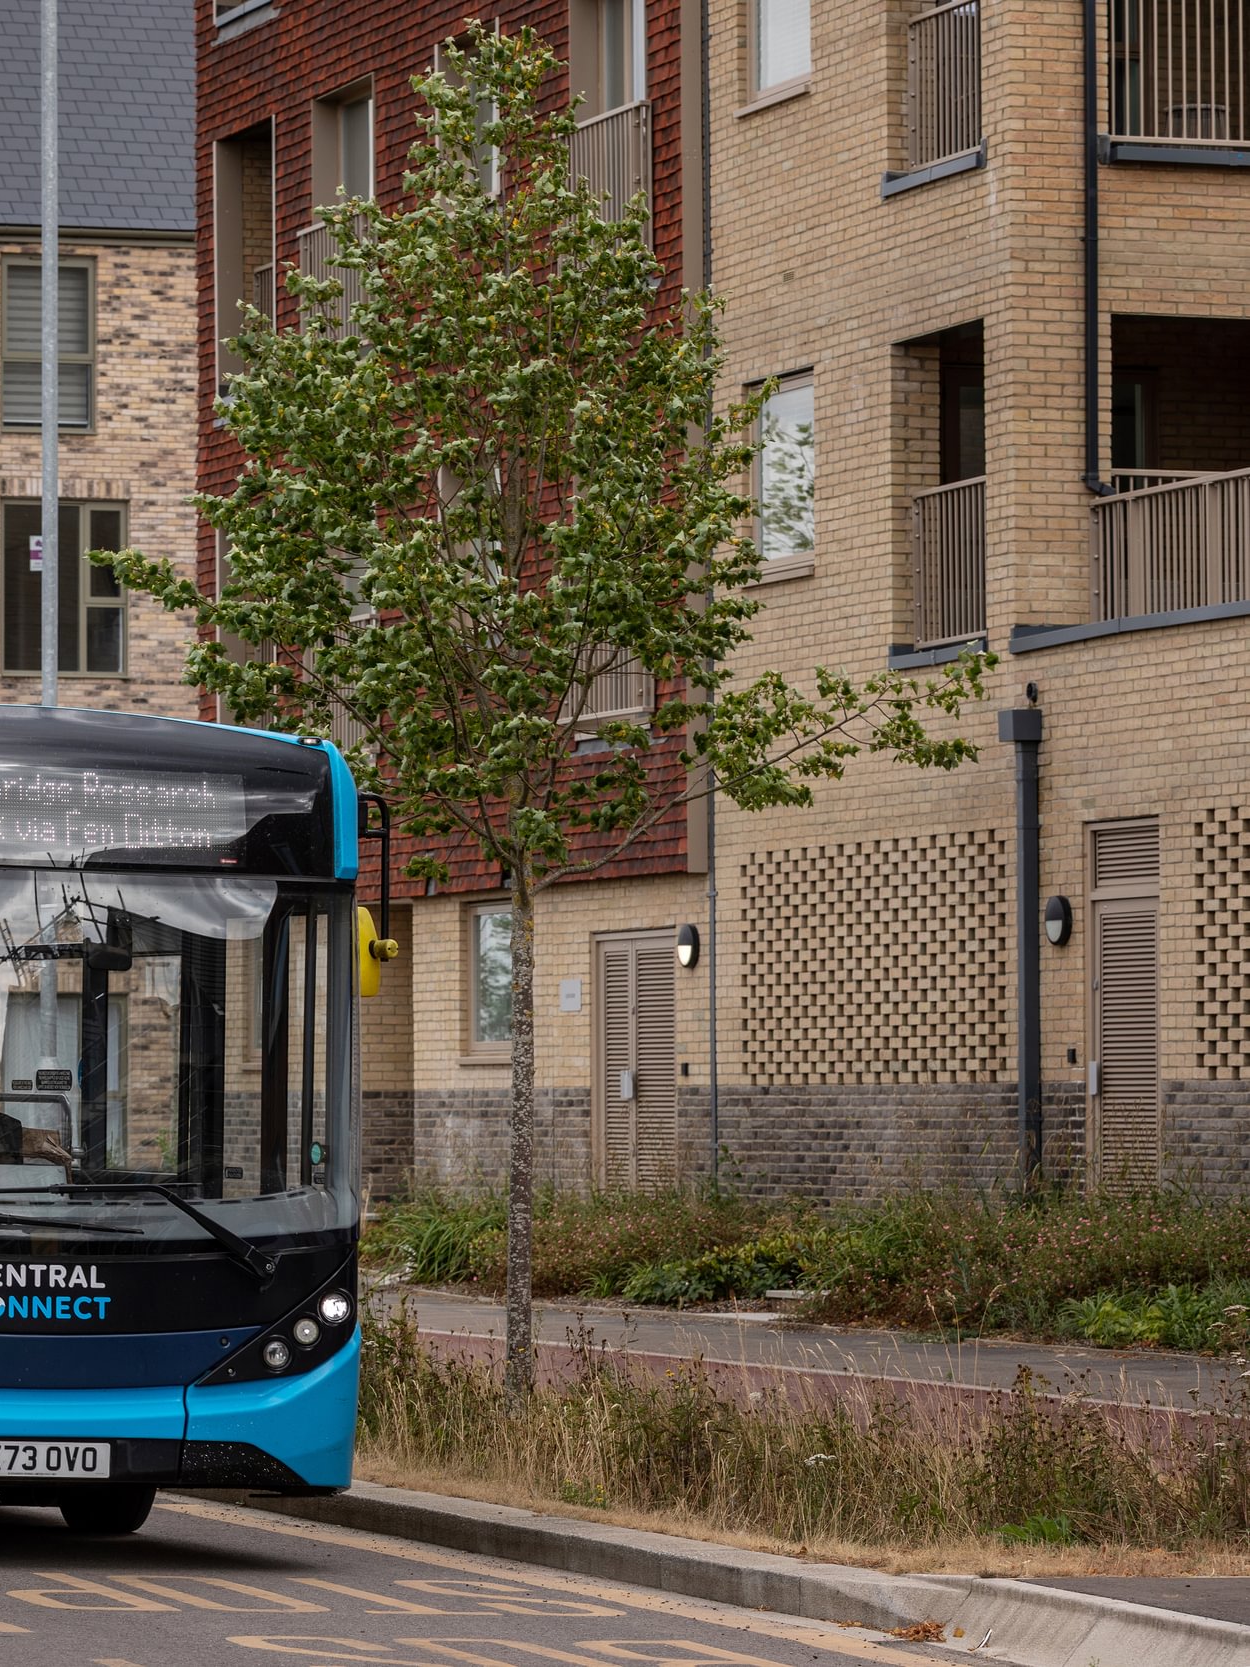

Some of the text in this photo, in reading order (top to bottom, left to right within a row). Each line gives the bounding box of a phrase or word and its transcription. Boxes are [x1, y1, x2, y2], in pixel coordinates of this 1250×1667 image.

[84, 772, 215, 808] Research
[16, 818, 55, 841] via
[66, 811, 114, 846] Fen
[125, 814, 210, 849] Ditton
[46, 1446, 97, 1472] OVO
[6, 1572, 627, 1616] STOP
